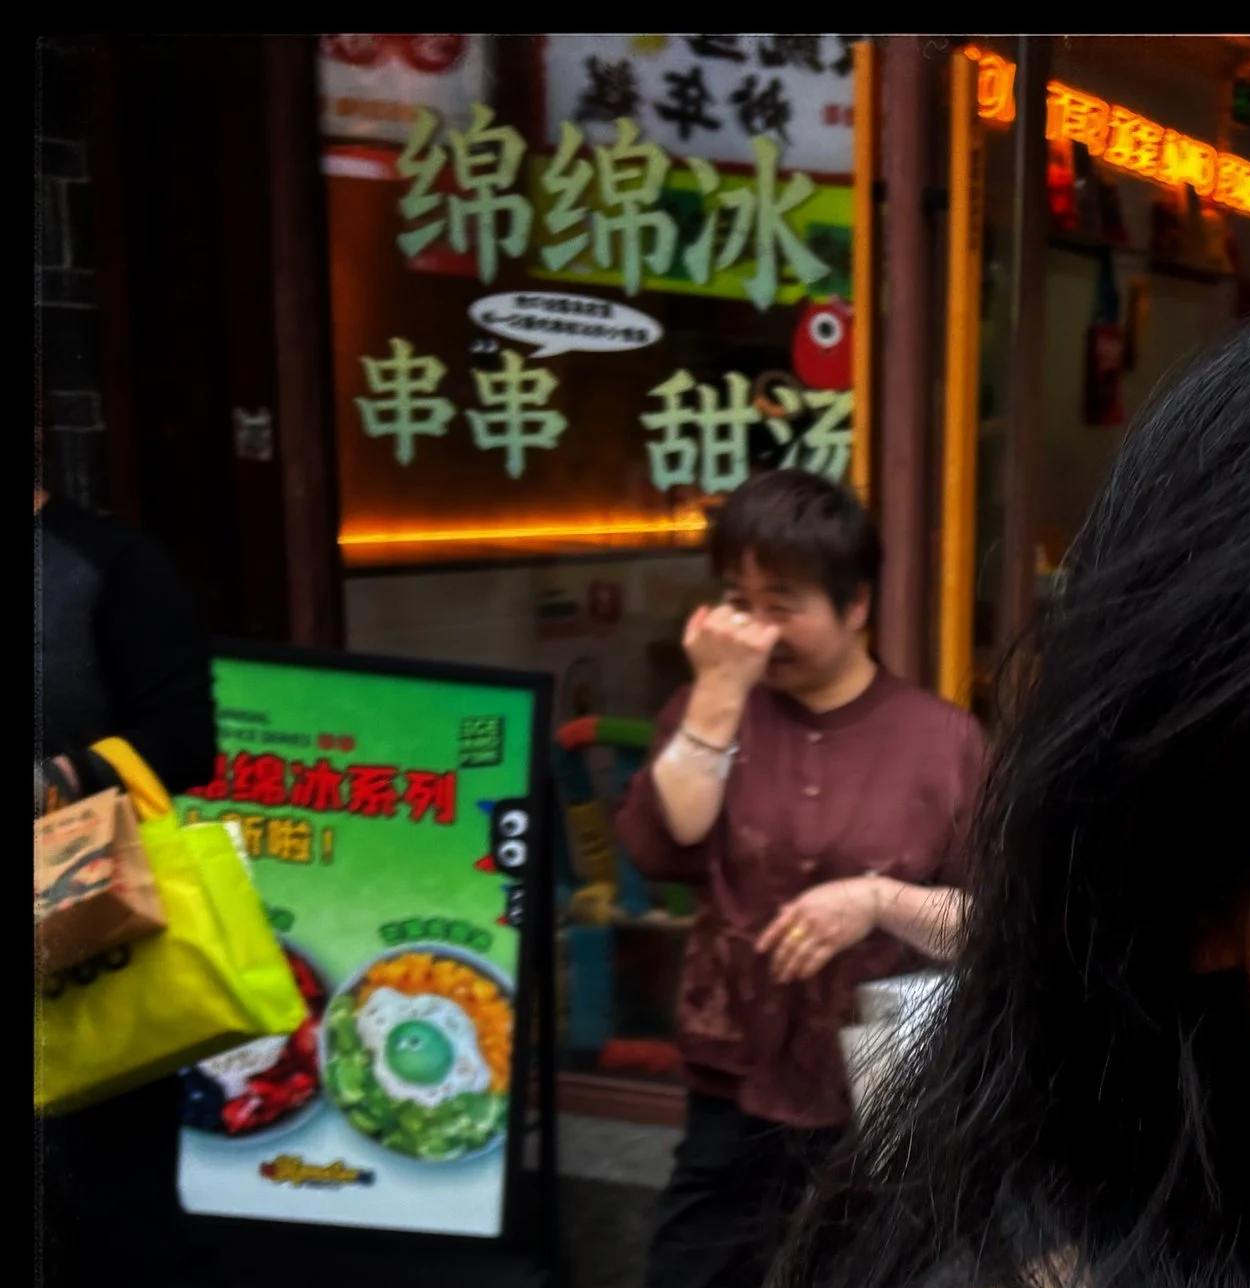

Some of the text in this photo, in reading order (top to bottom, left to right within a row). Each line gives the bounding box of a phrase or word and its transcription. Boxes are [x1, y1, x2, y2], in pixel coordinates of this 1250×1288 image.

[396, 100, 832, 312] 绵绵冰
[355, 337, 854, 495] 串串 甜汤
